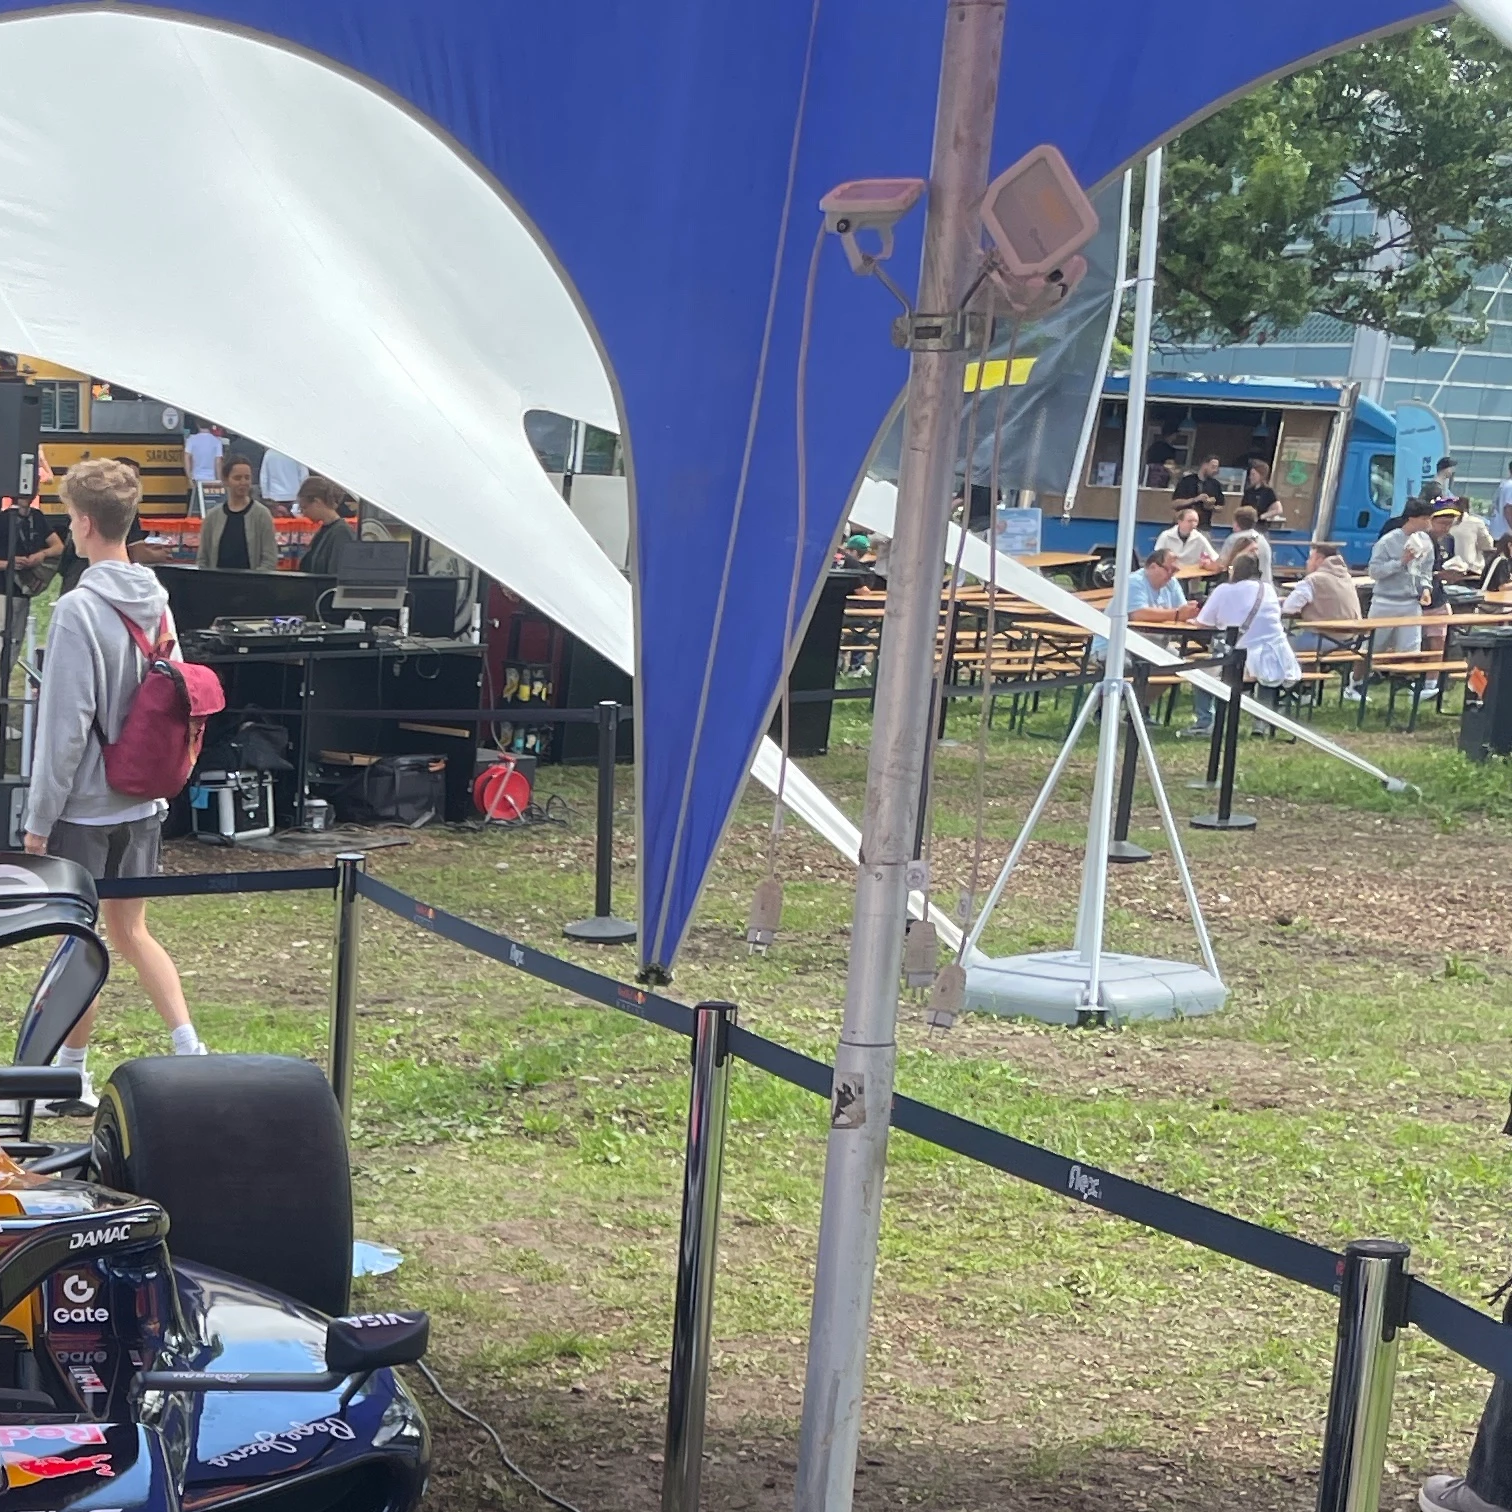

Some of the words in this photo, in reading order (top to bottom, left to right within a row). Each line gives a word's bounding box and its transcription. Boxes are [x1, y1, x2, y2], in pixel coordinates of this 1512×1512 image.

[69, 1224, 131, 1250] DAMAC
[53, 1306, 110, 1325] Gate
[340, 1312, 416, 1329] VISA
[280, 1417, 357, 1442] Pepe
[208, 1430, 298, 1468] Jeans
